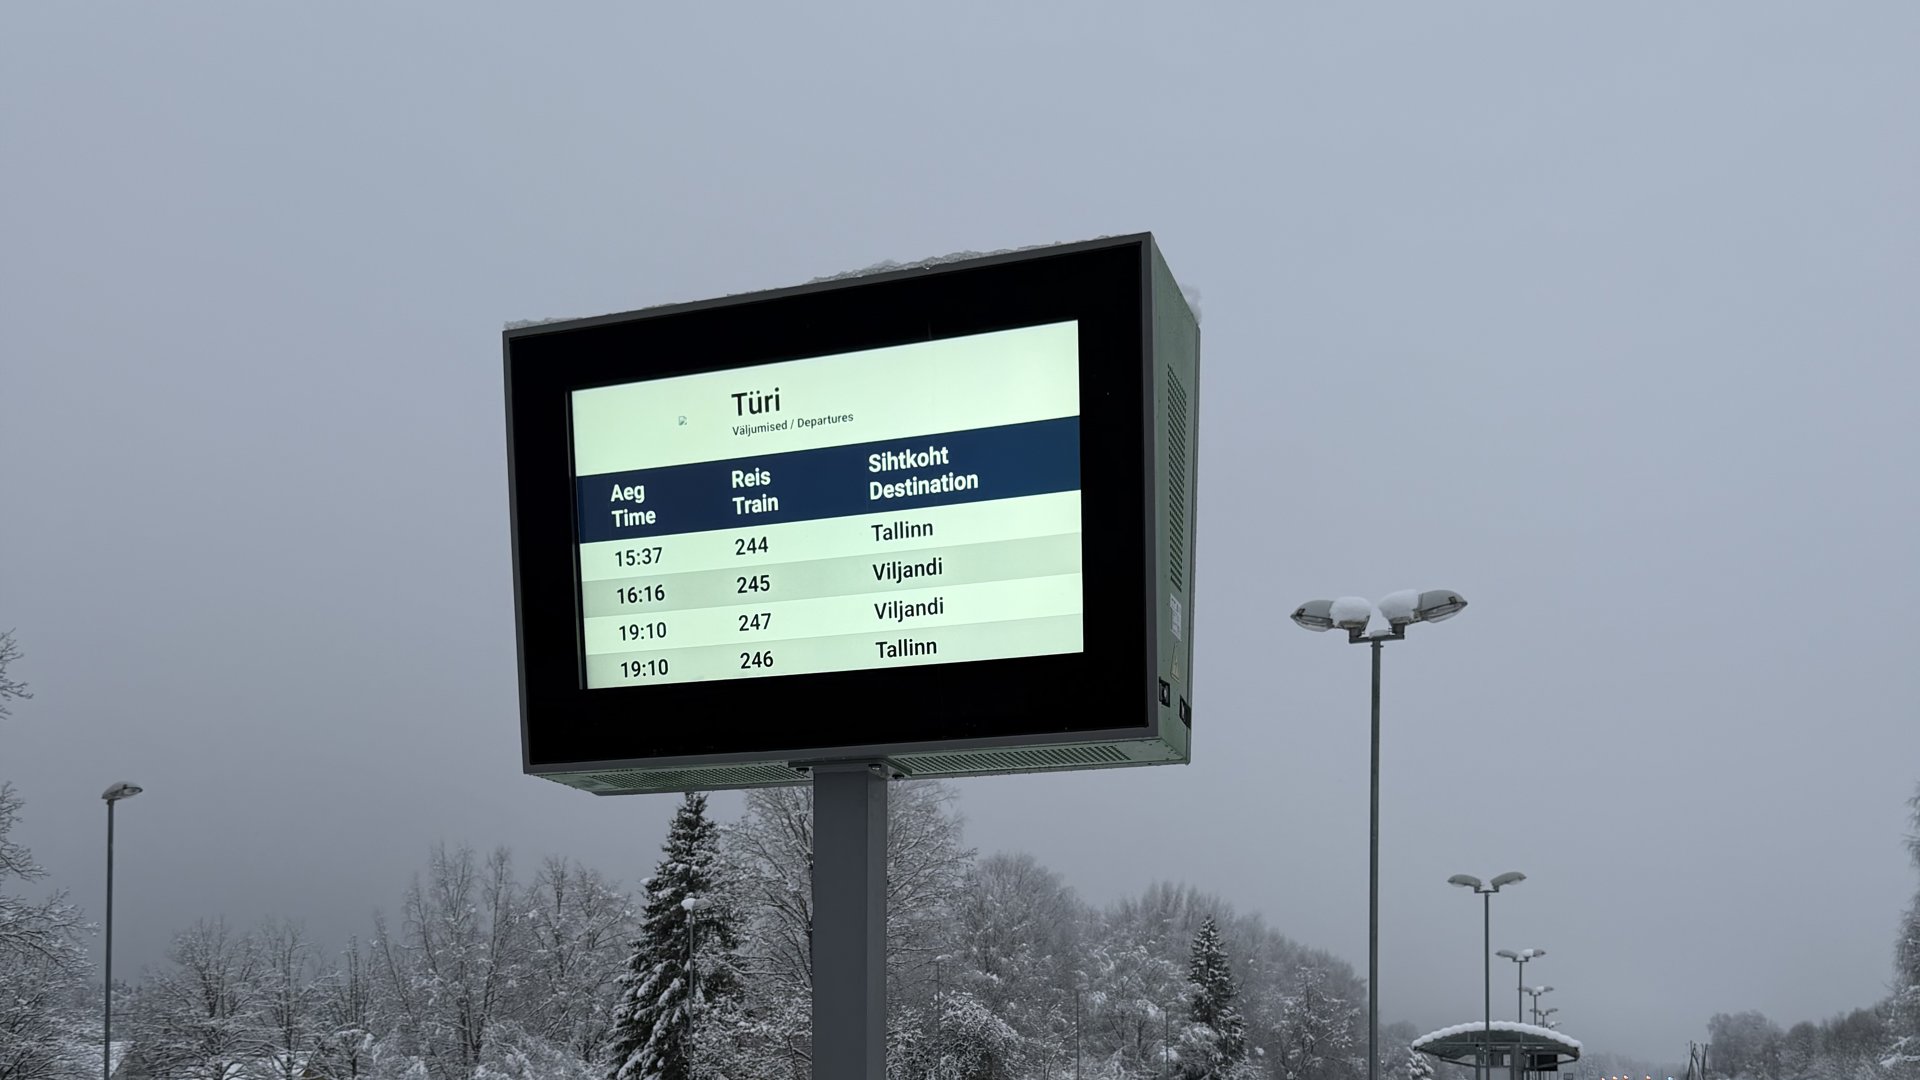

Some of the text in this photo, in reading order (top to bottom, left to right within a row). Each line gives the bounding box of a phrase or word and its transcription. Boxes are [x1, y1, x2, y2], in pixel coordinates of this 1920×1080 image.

[731, 387, 780, 416] Türi
[732, 413, 854, 437] Väljumised / Departures
[611, 446, 949, 503] Aeg Reis Sihtkoht
[612, 472, 979, 527] Time Train Destination
[615, 521, 933, 566] 15:37 244 Tallinn
[617, 557, 942, 604] 16:16 245 Viljandi
[619, 597, 943, 641] 19:10 247 Viljandi
[621, 639, 936, 677] 19:10 246 Tallinn
